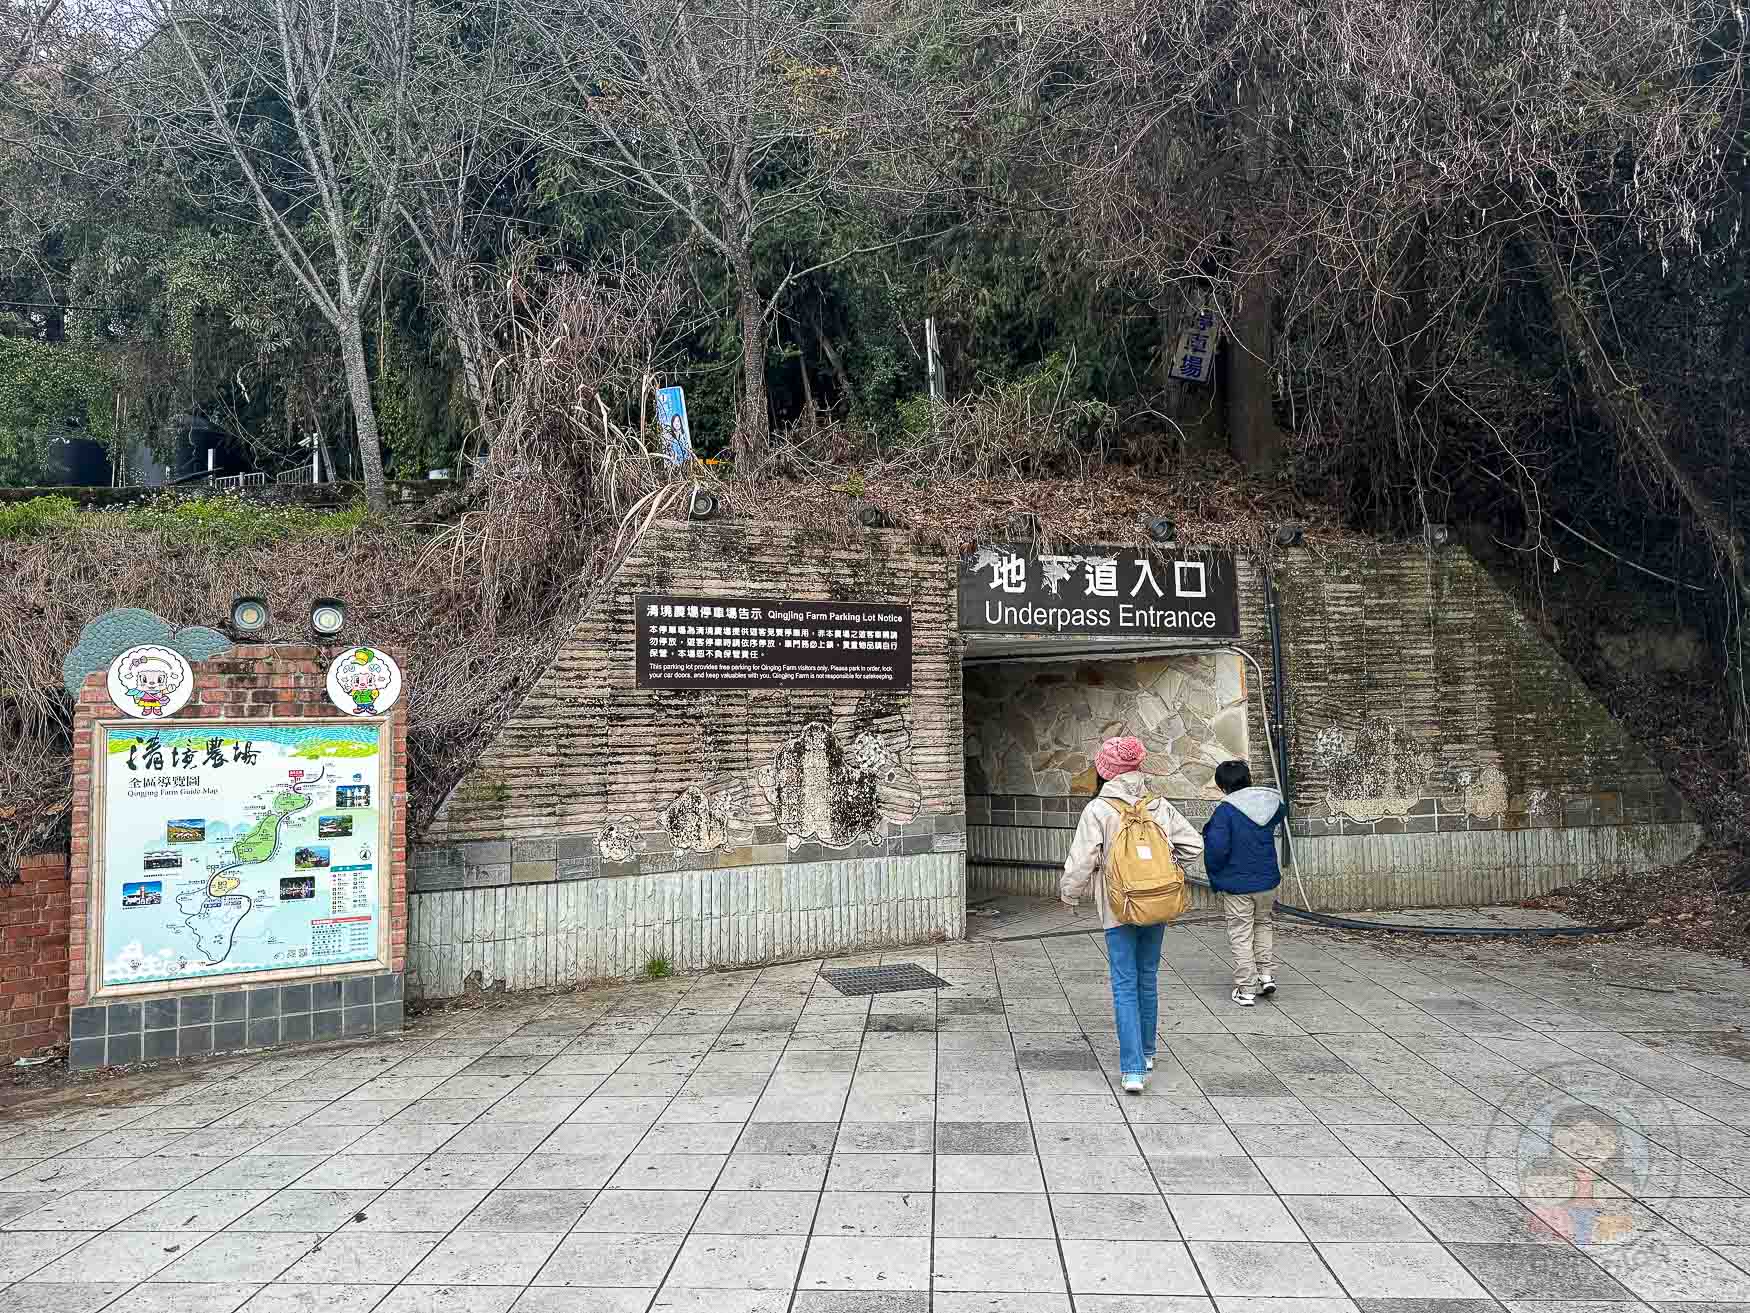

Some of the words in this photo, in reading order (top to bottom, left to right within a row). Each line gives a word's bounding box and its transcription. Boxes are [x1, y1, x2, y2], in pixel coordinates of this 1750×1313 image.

[989, 553, 1206, 598] 地下道入口
[646, 604, 762, 620] 清境農場停車場告示
[767, 610, 804, 622] Qingjing
[806, 611, 827, 621] Farm
[829, 612, 861, 623] Parking
[862, 613, 876, 622] Lot
[877, 613, 903, 622] Notice
[985, 600, 1111, 631] Underpass
[1119, 604, 1216, 628] Entrance
[663, 663, 684, 671] parking
[694, 663, 718, 671] provides
[126, 731, 261, 770] 清境農場
[128, 776, 200, 788] 全區導覽圖
[160, 788, 178, 797] Farm
[180, 787, 201, 795] Guide
[202, 787, 218, 795] Map
